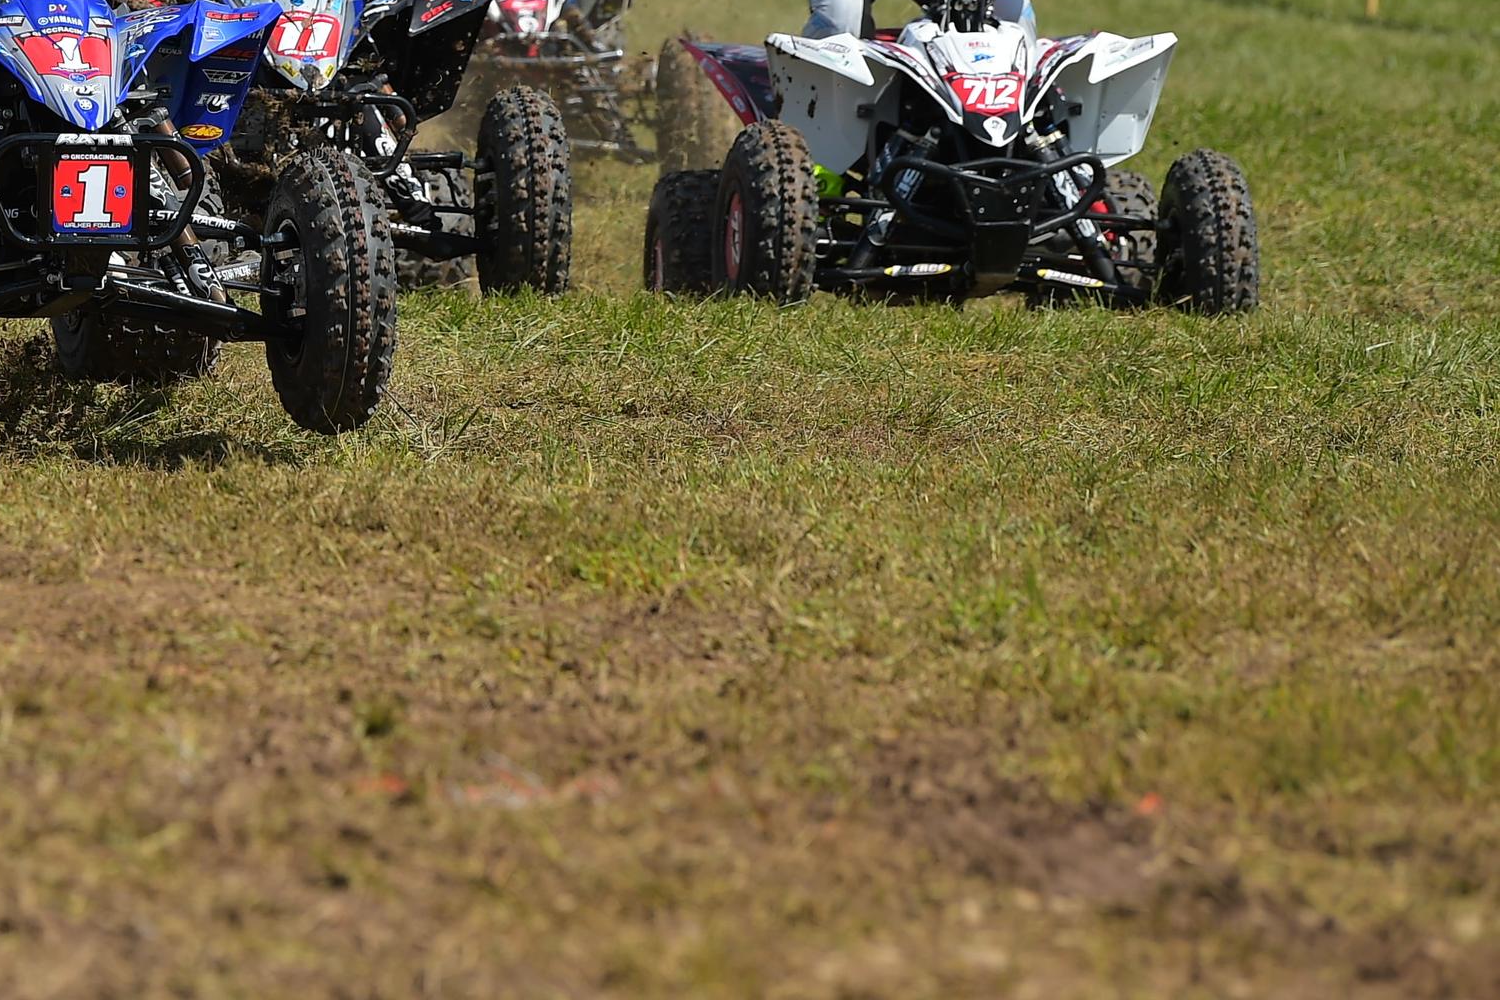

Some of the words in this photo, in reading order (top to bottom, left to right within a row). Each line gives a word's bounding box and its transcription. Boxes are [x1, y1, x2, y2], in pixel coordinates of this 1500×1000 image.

[49, 15, 84, 27] YAMAHA
[52, 35, 91, 70] 1
[198, 93, 234, 113] FOX
[963, 79, 1018, 105] 712
[73, 165, 111, 222] 1
[191, 213, 237, 231] RACING
[182, 243, 224, 299] FOX
